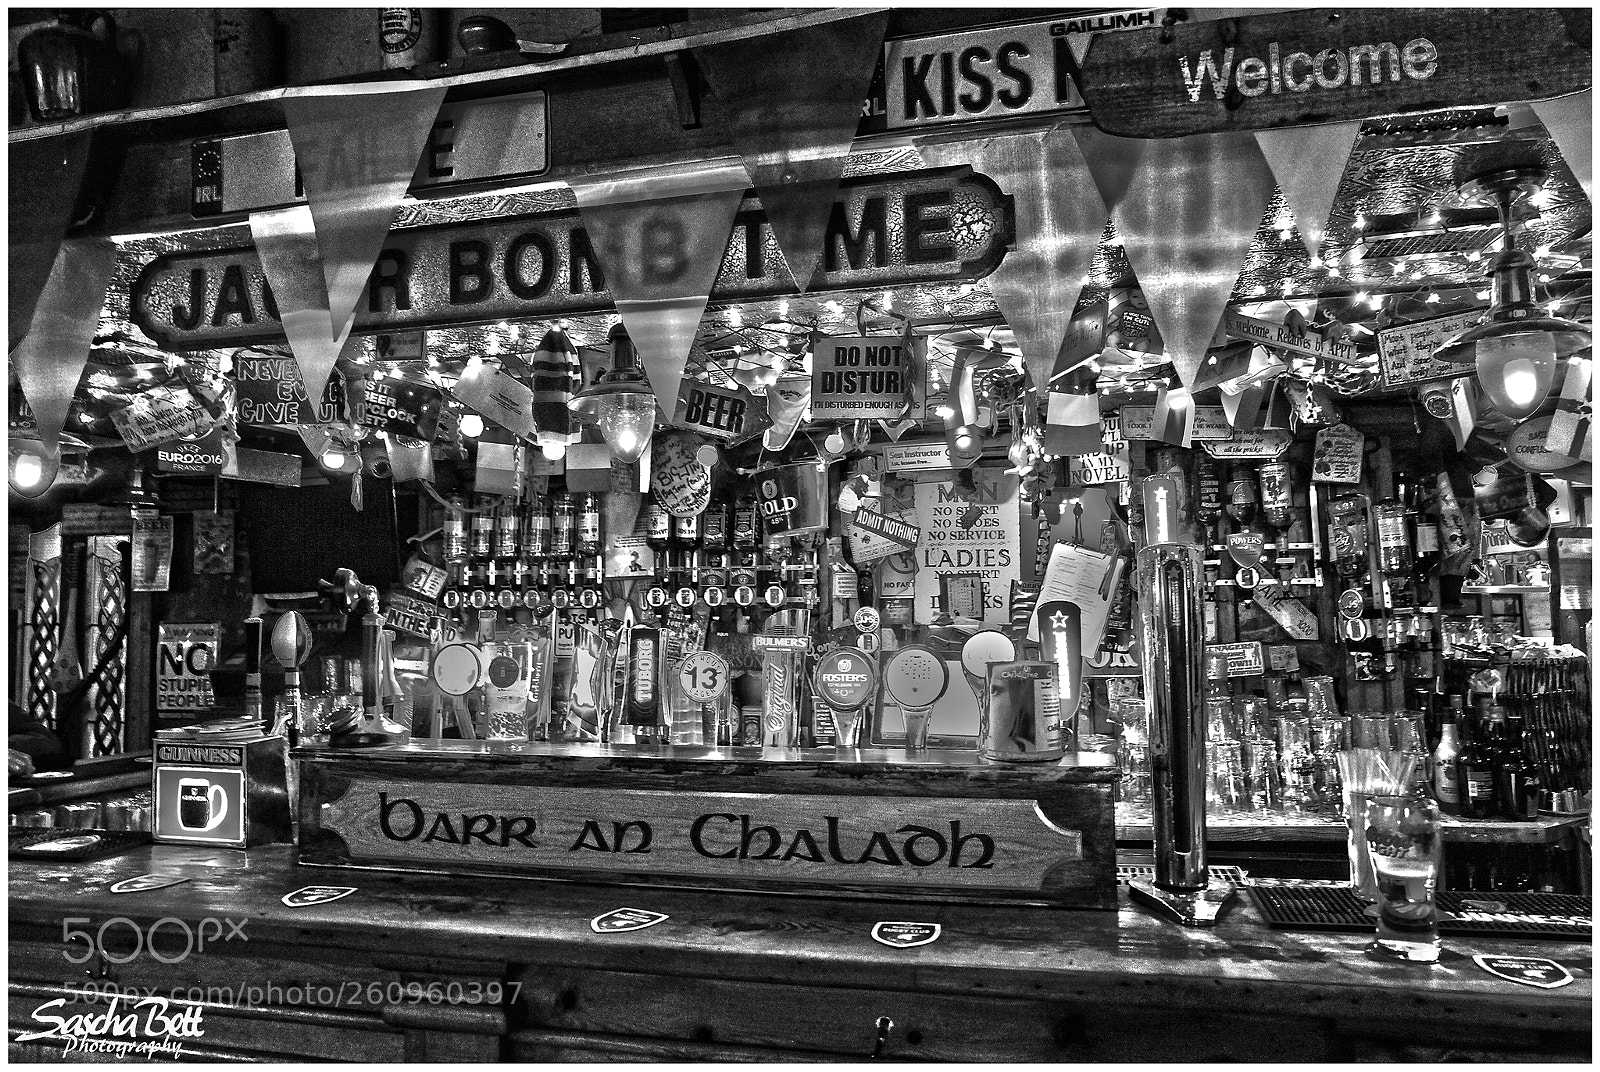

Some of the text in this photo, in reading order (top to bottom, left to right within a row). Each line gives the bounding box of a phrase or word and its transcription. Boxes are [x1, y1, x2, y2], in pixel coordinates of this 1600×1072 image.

[1050, 11, 1155, 37] GAILLIMH
[1178, 37, 1438, 102] Welcome
[902, 41, 1034, 121] KISS
[860, 97, 887, 118] RL
[195, 186, 221, 203] IRL
[171, 247, 411, 331] JAR
[733, 190, 956, 280] TME
[834, 345, 902, 367] DO NOT
[378, 383, 392, 395] IT
[364, 390, 397, 408] BEER
[825, 401, 864, 409] DISTURBED
[865, 401, 893, 409] ENOUGH
[240, 398, 299, 424] GIVE
[684, 388, 748, 435] BEER
[903, 450, 942, 459] Instructor
[1105, 442, 1125, 455] UP
[172, 463, 207, 472] FRANCE
[1070, 466, 1129, 484] NOVEL.
[933, 507, 952, 516] NO
[856, 509, 919, 543] ADMIT NOTHING
[933, 518, 1000, 528] NO SOES
[928, 529, 1006, 541] NO SERVICE
[1229, 536, 1262, 546] POWERS
[924, 548, 1011, 568] LADIES
[756, 637, 808, 648] BULMERS
[159, 643, 211, 676] NO
[636, 638, 653, 702] TUBORG
[686, 666, 718, 689] 13
[822, 673, 868, 682] FOSTER'S
[689, 687, 717, 698] LAGER
[765, 662, 794, 733] Original
[158, 745, 241, 764] GUINNESS
[689, 812, 997, 870] Chaladh
